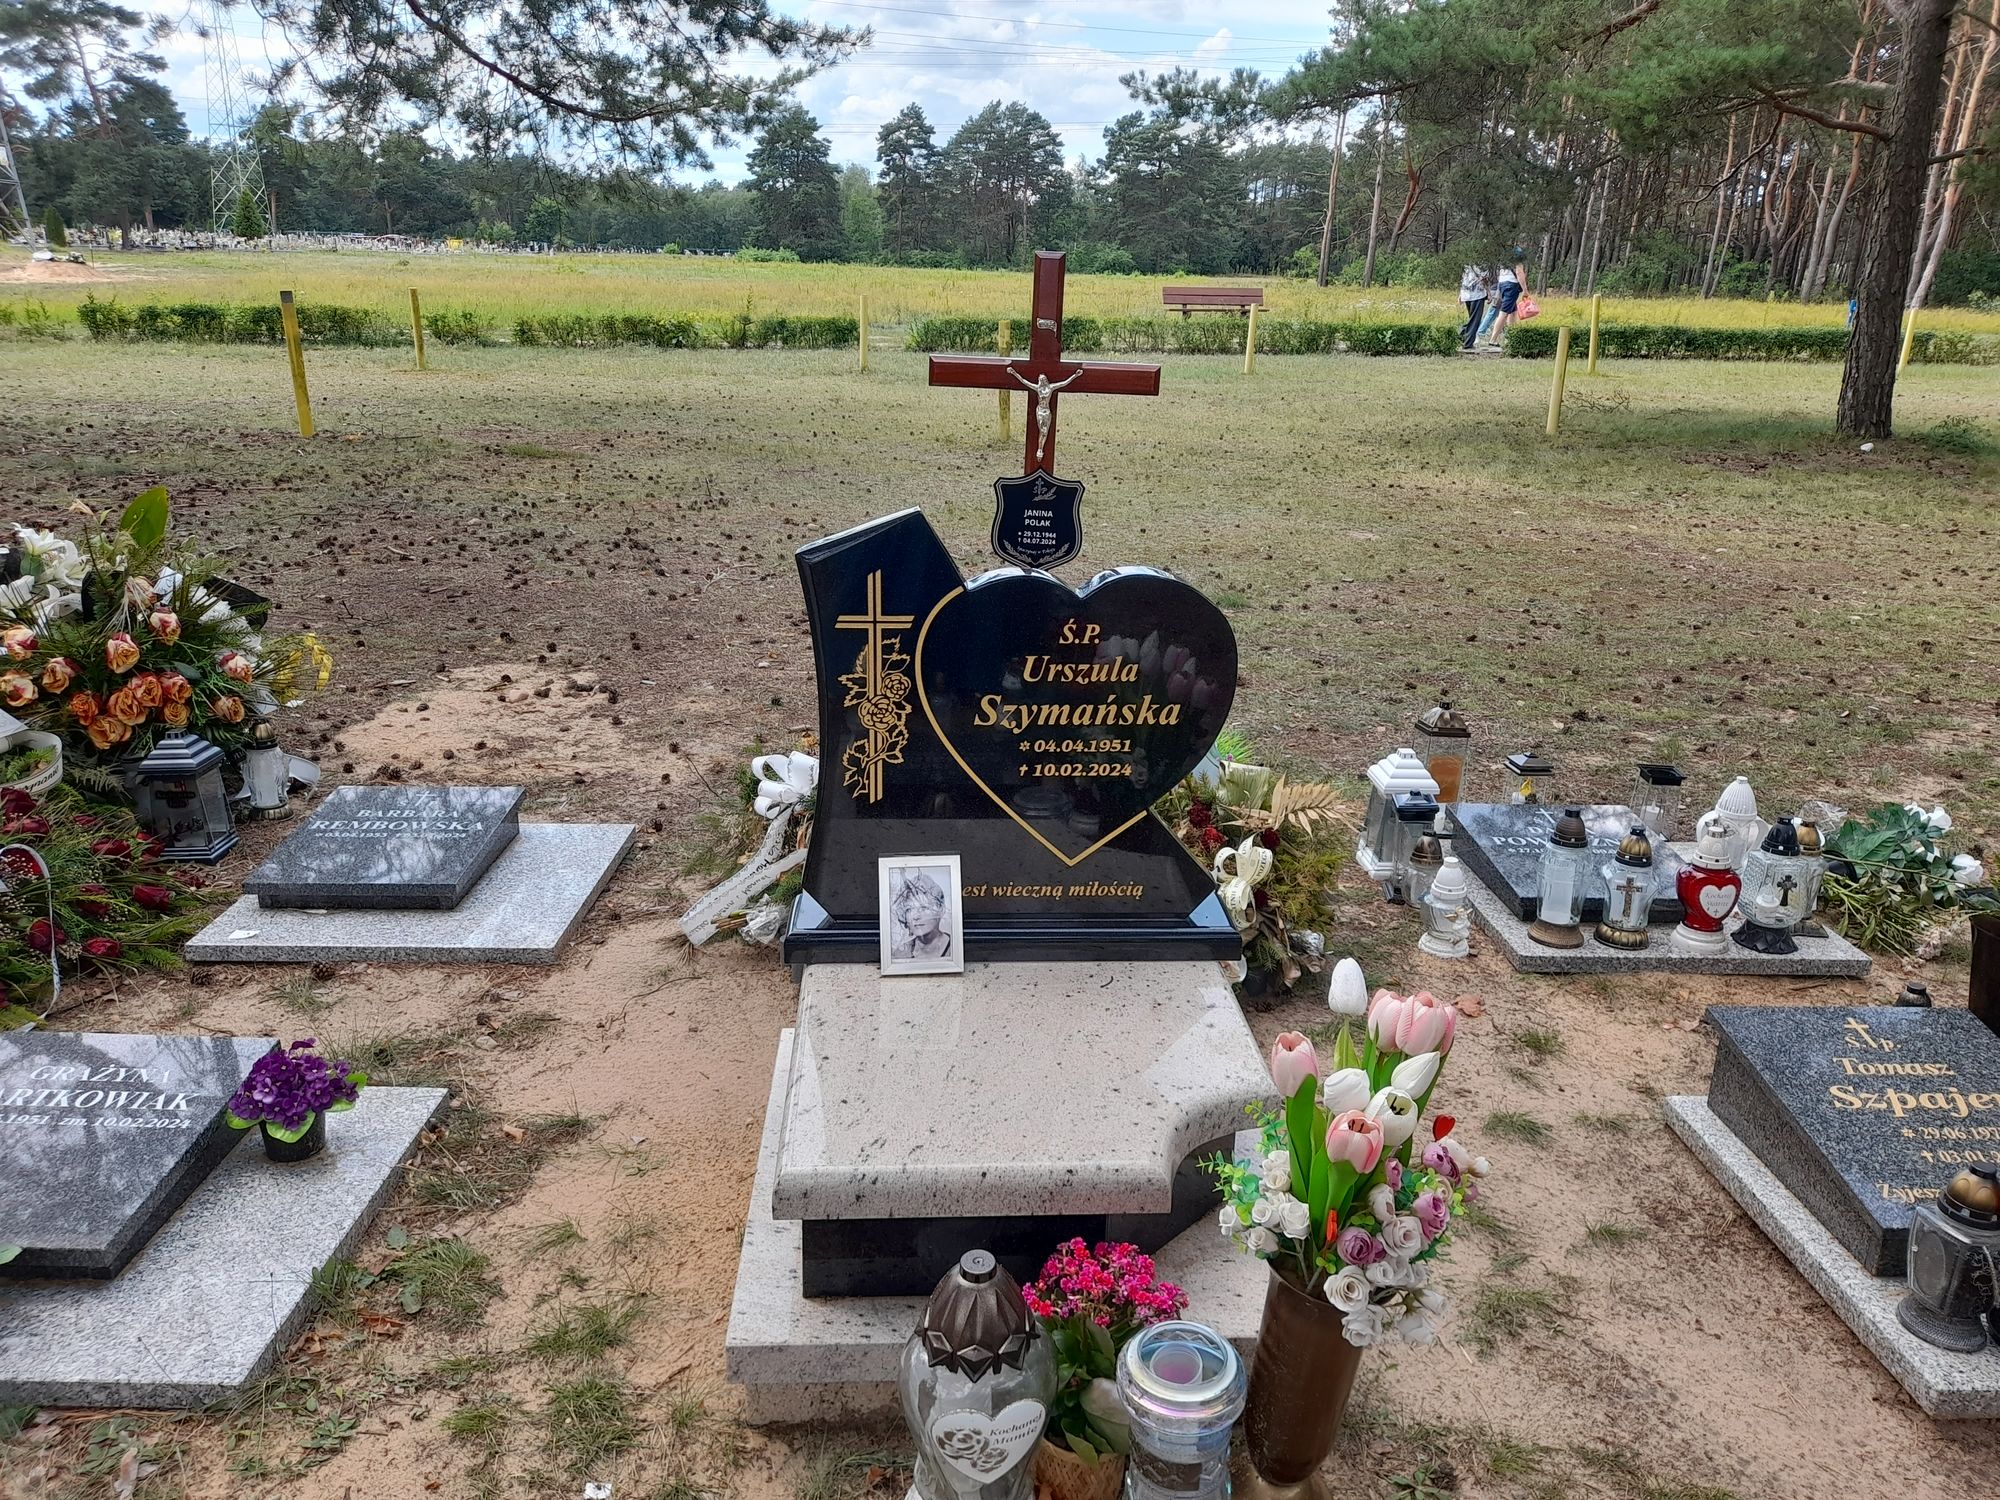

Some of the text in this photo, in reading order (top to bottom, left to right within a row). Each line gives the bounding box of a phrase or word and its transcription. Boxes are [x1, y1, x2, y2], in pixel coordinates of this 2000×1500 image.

[1024, 509, 1053, 518] JANINA
[1024, 519, 1051, 527] POLAK
[1023, 531, 1056, 539] 29.12.1944
[1059, 618, 1101, 645] Ś.P.
[1022, 655, 1139, 685] Urszula
[973, 694, 1181, 734] Szymańska
[1034, 739, 1132, 753] 04.04.1951
[1032, 763, 1132, 777] 10.02.2024
[356, 809, 459, 818] BARBARA
[309, 820, 485, 831] REMBOWSKA
[962, 881, 1144, 900] est wieczną miłością
[1832, 1056, 1955, 1076] Tomasz
[30, 1064, 170, 1084] GRAŻYNA
[58, 1118, 88, 1126] zm.
[93, 1117, 192, 1129] 10.02.2024
